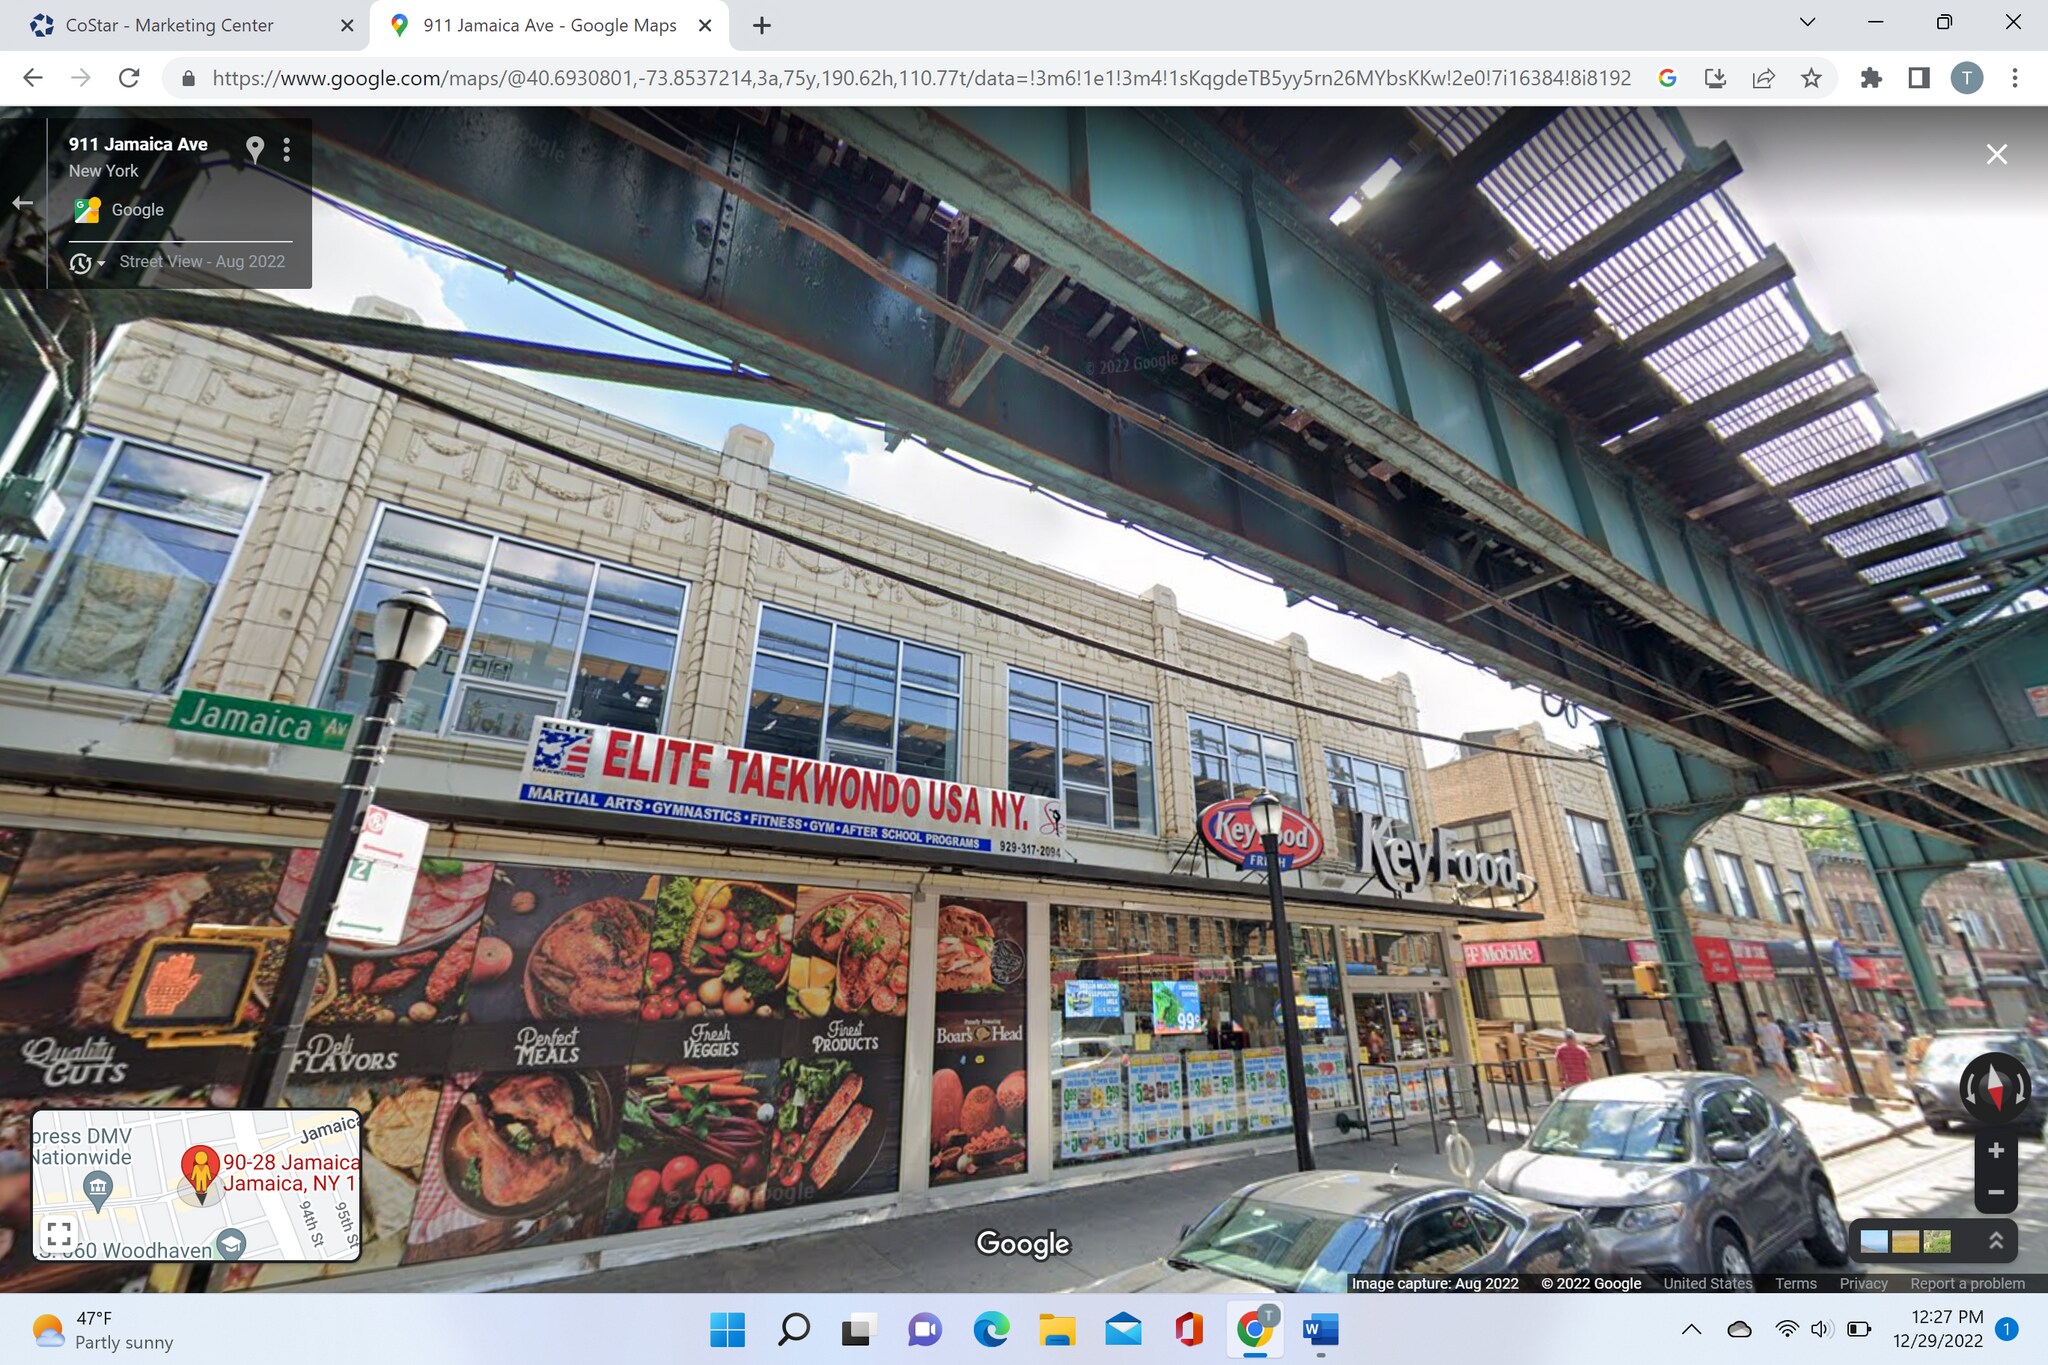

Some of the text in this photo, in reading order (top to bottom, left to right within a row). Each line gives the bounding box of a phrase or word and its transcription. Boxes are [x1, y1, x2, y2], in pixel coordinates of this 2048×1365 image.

[66, 19, 118, 33] CoStar
[135, 18, 216, 37] Marketing
[221, 18, 274, 33] Center
[424, 19, 451, 33] 911
[458, 18, 519, 33] Jamaica
[525, 19, 554, 33] Ave
[571, 18, 629, 37] Google
[634, 18, 677, 37] Maps
[1961, 71, 1973, 85] T
[180, 698, 348, 741] Jamaica Av
[543, 722, 595, 736] ELITE
[603, 730, 1028, 831] ELITE TAEKWONDO USA NY.
[527, 785, 980, 850] MARTIAL ARTS GYMNASTICS FITNESS GYM AFTER SCHOOL PROGRAMS
[1215, 811, 1309, 849] Key od
[999, 840, 1061, 859] 929-317-2094
[1357, 811, 1520, 893] Key Food
[353, 859, 367, 879] 2
[1250, 855, 1286, 868] FRH
[517, 1026, 581, 1048] Perfect
[691, 1023, 731, 1042] Fresh
[827, 1019, 864, 1038] Finest
[937, 1025, 1023, 1044] Boar's Head
[21, 1036, 118, 1069] Quality
[307, 1033, 355, 1060] Deli
[683, 1041, 739, 1059] VEGGIES
[812, 1035, 879, 1054] PRODUCTS
[289, 1050, 399, 1074] FLAVORS
[515, 1046, 580, 1067] MEALS
[77, 1311, 112, 1326] 47°F
[1912, 1309, 1984, 1324] 12:27 PM
[2004, 1323, 2010, 1336] 1
[76, 1335, 173, 1354] Partly sunny
[1893, 1333, 1984, 1350] 12/29/2022
